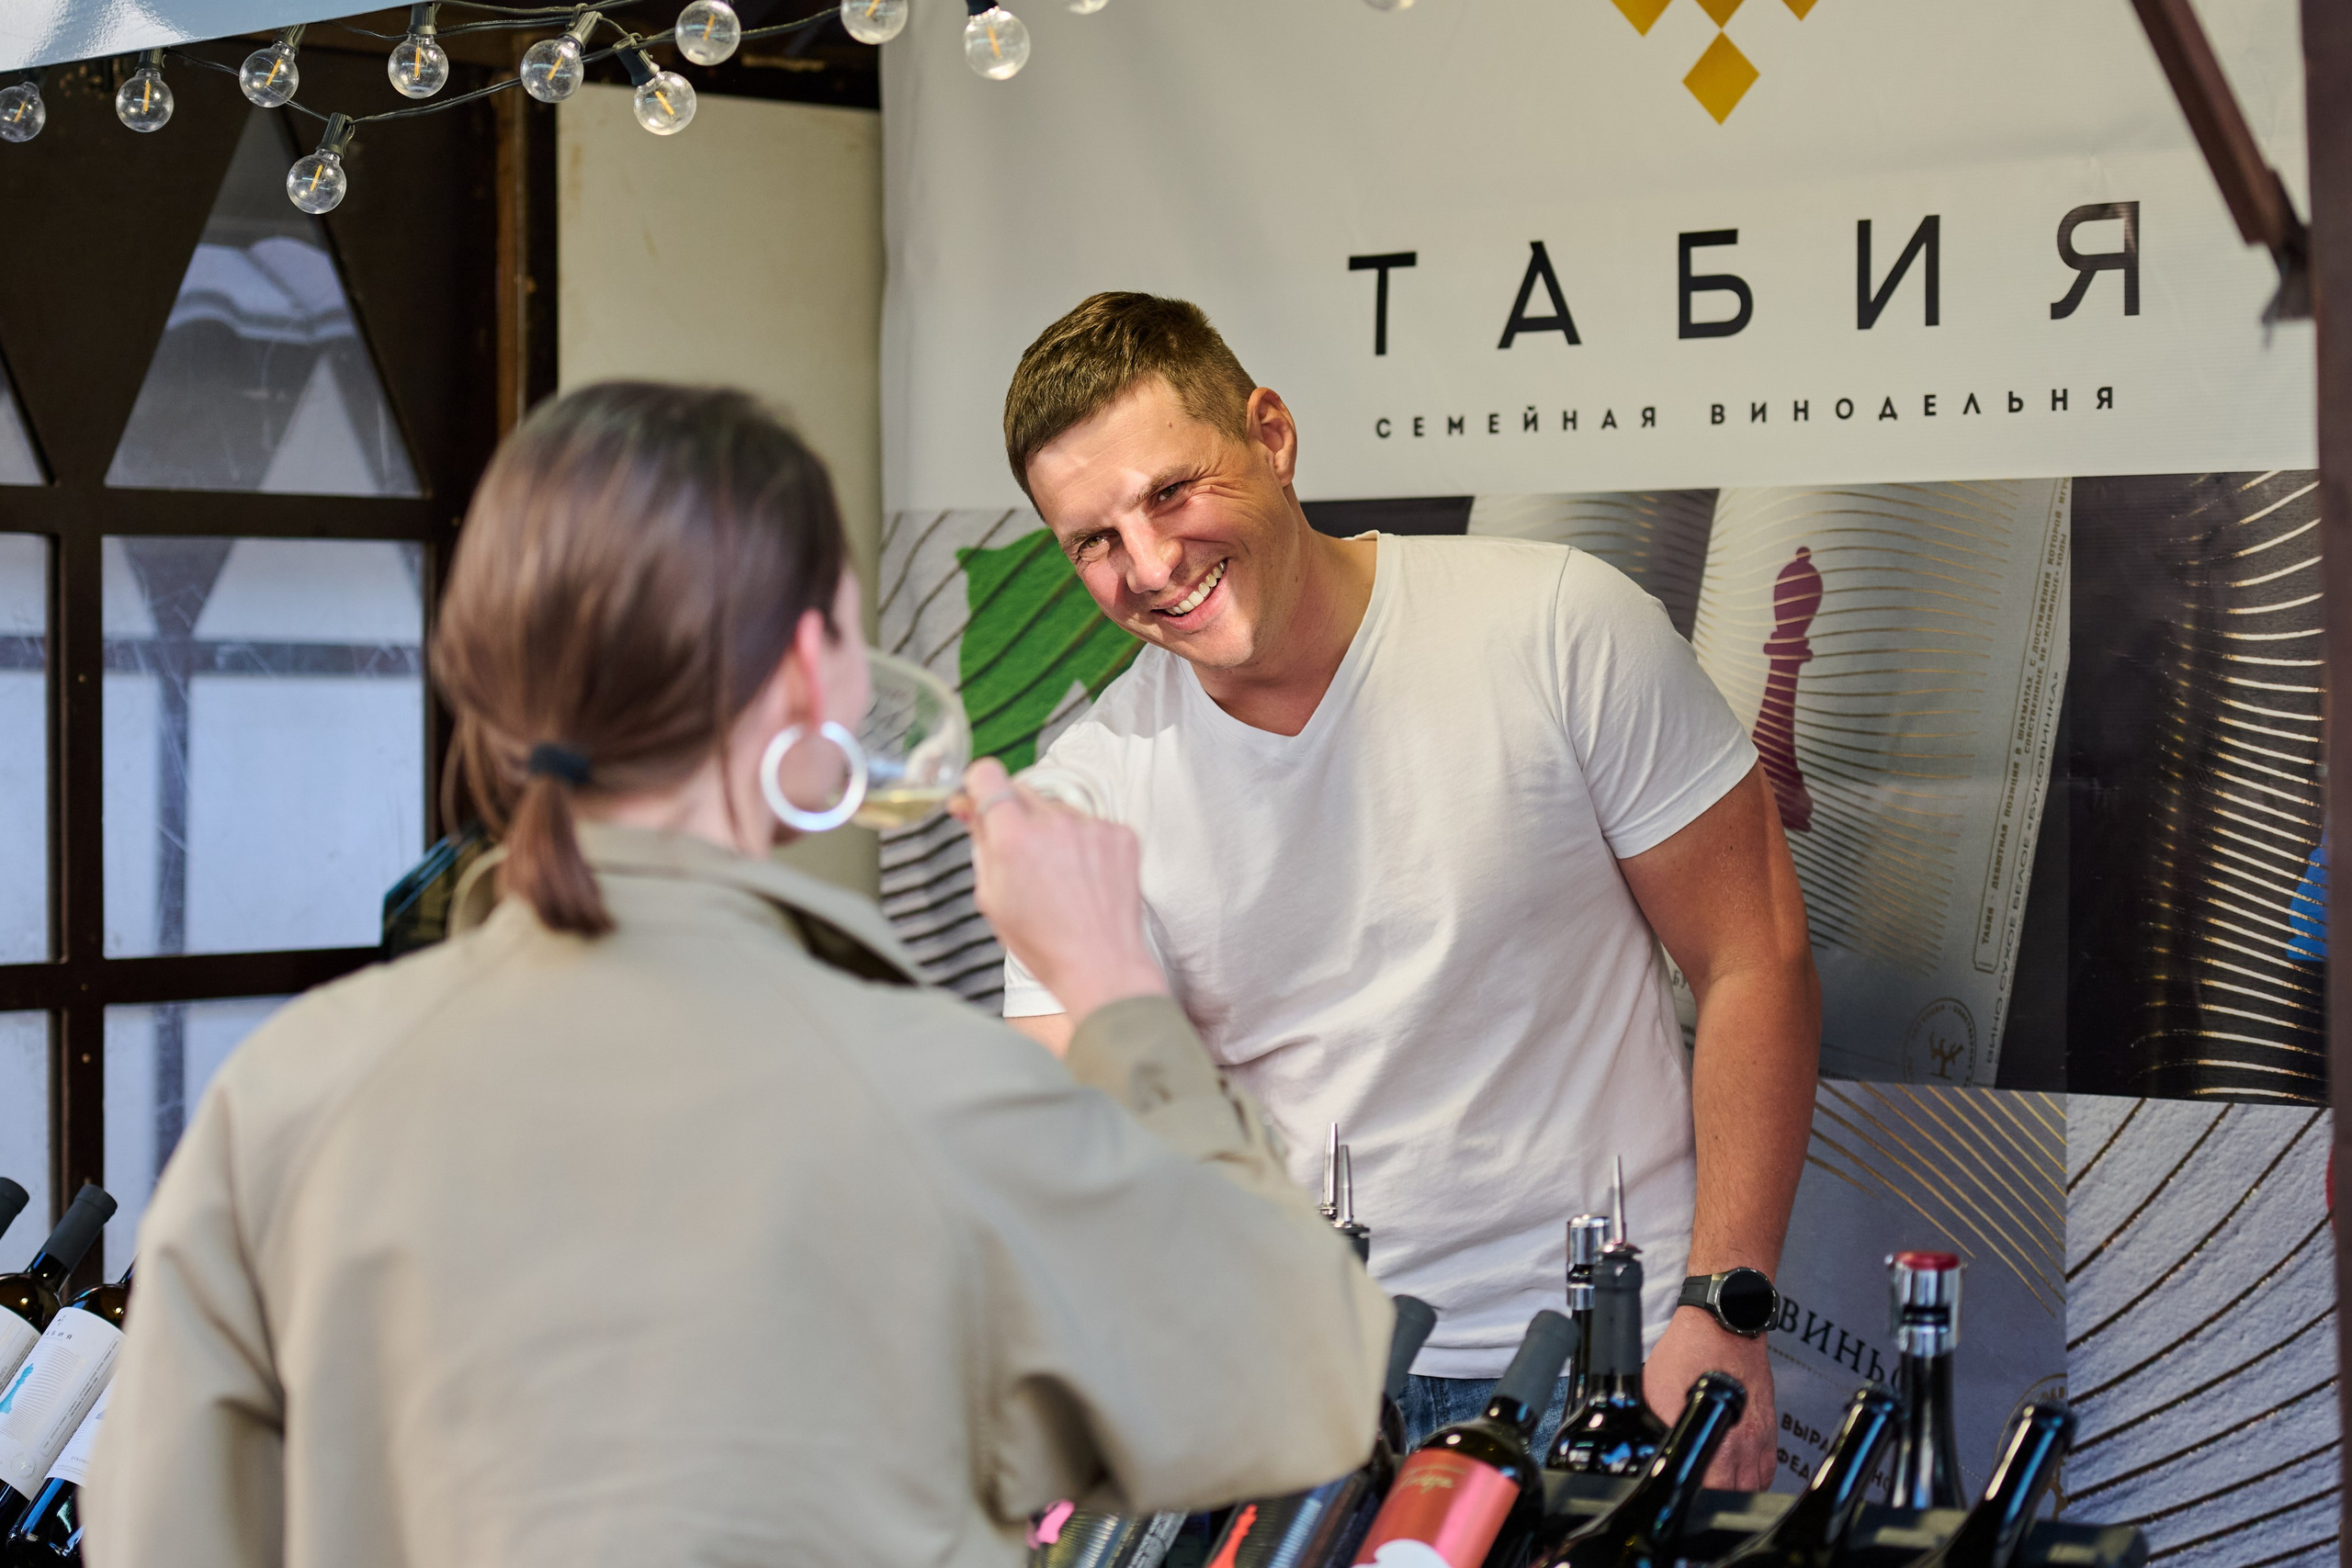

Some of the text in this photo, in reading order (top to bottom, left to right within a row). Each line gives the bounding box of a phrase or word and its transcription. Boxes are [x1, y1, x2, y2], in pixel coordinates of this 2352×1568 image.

[1348, 201, 2140, 355] ТАБИЯ
[1376, 387, 2112, 438] СЕМЕЙНАЯ ВИНОДЕЛЬНЯ
[1982, 908, 1994, 944] ТАБИЯ
[1992, 825, 2007, 890] ДЕБЮТНАЯ
[2004, 762, 2020, 817] ПОЗИЦИЯ
[2031, 572, 2051, 653] ДОСТИЖЕНИЯ
[2047, 511, 2062, 565] КОТОРОЙ
[1986, 998, 2003, 1064] ВИНО
[1999, 918, 2017, 991] СУХОЕ
[2012, 838, 2030, 910] БЕЛОЕ
